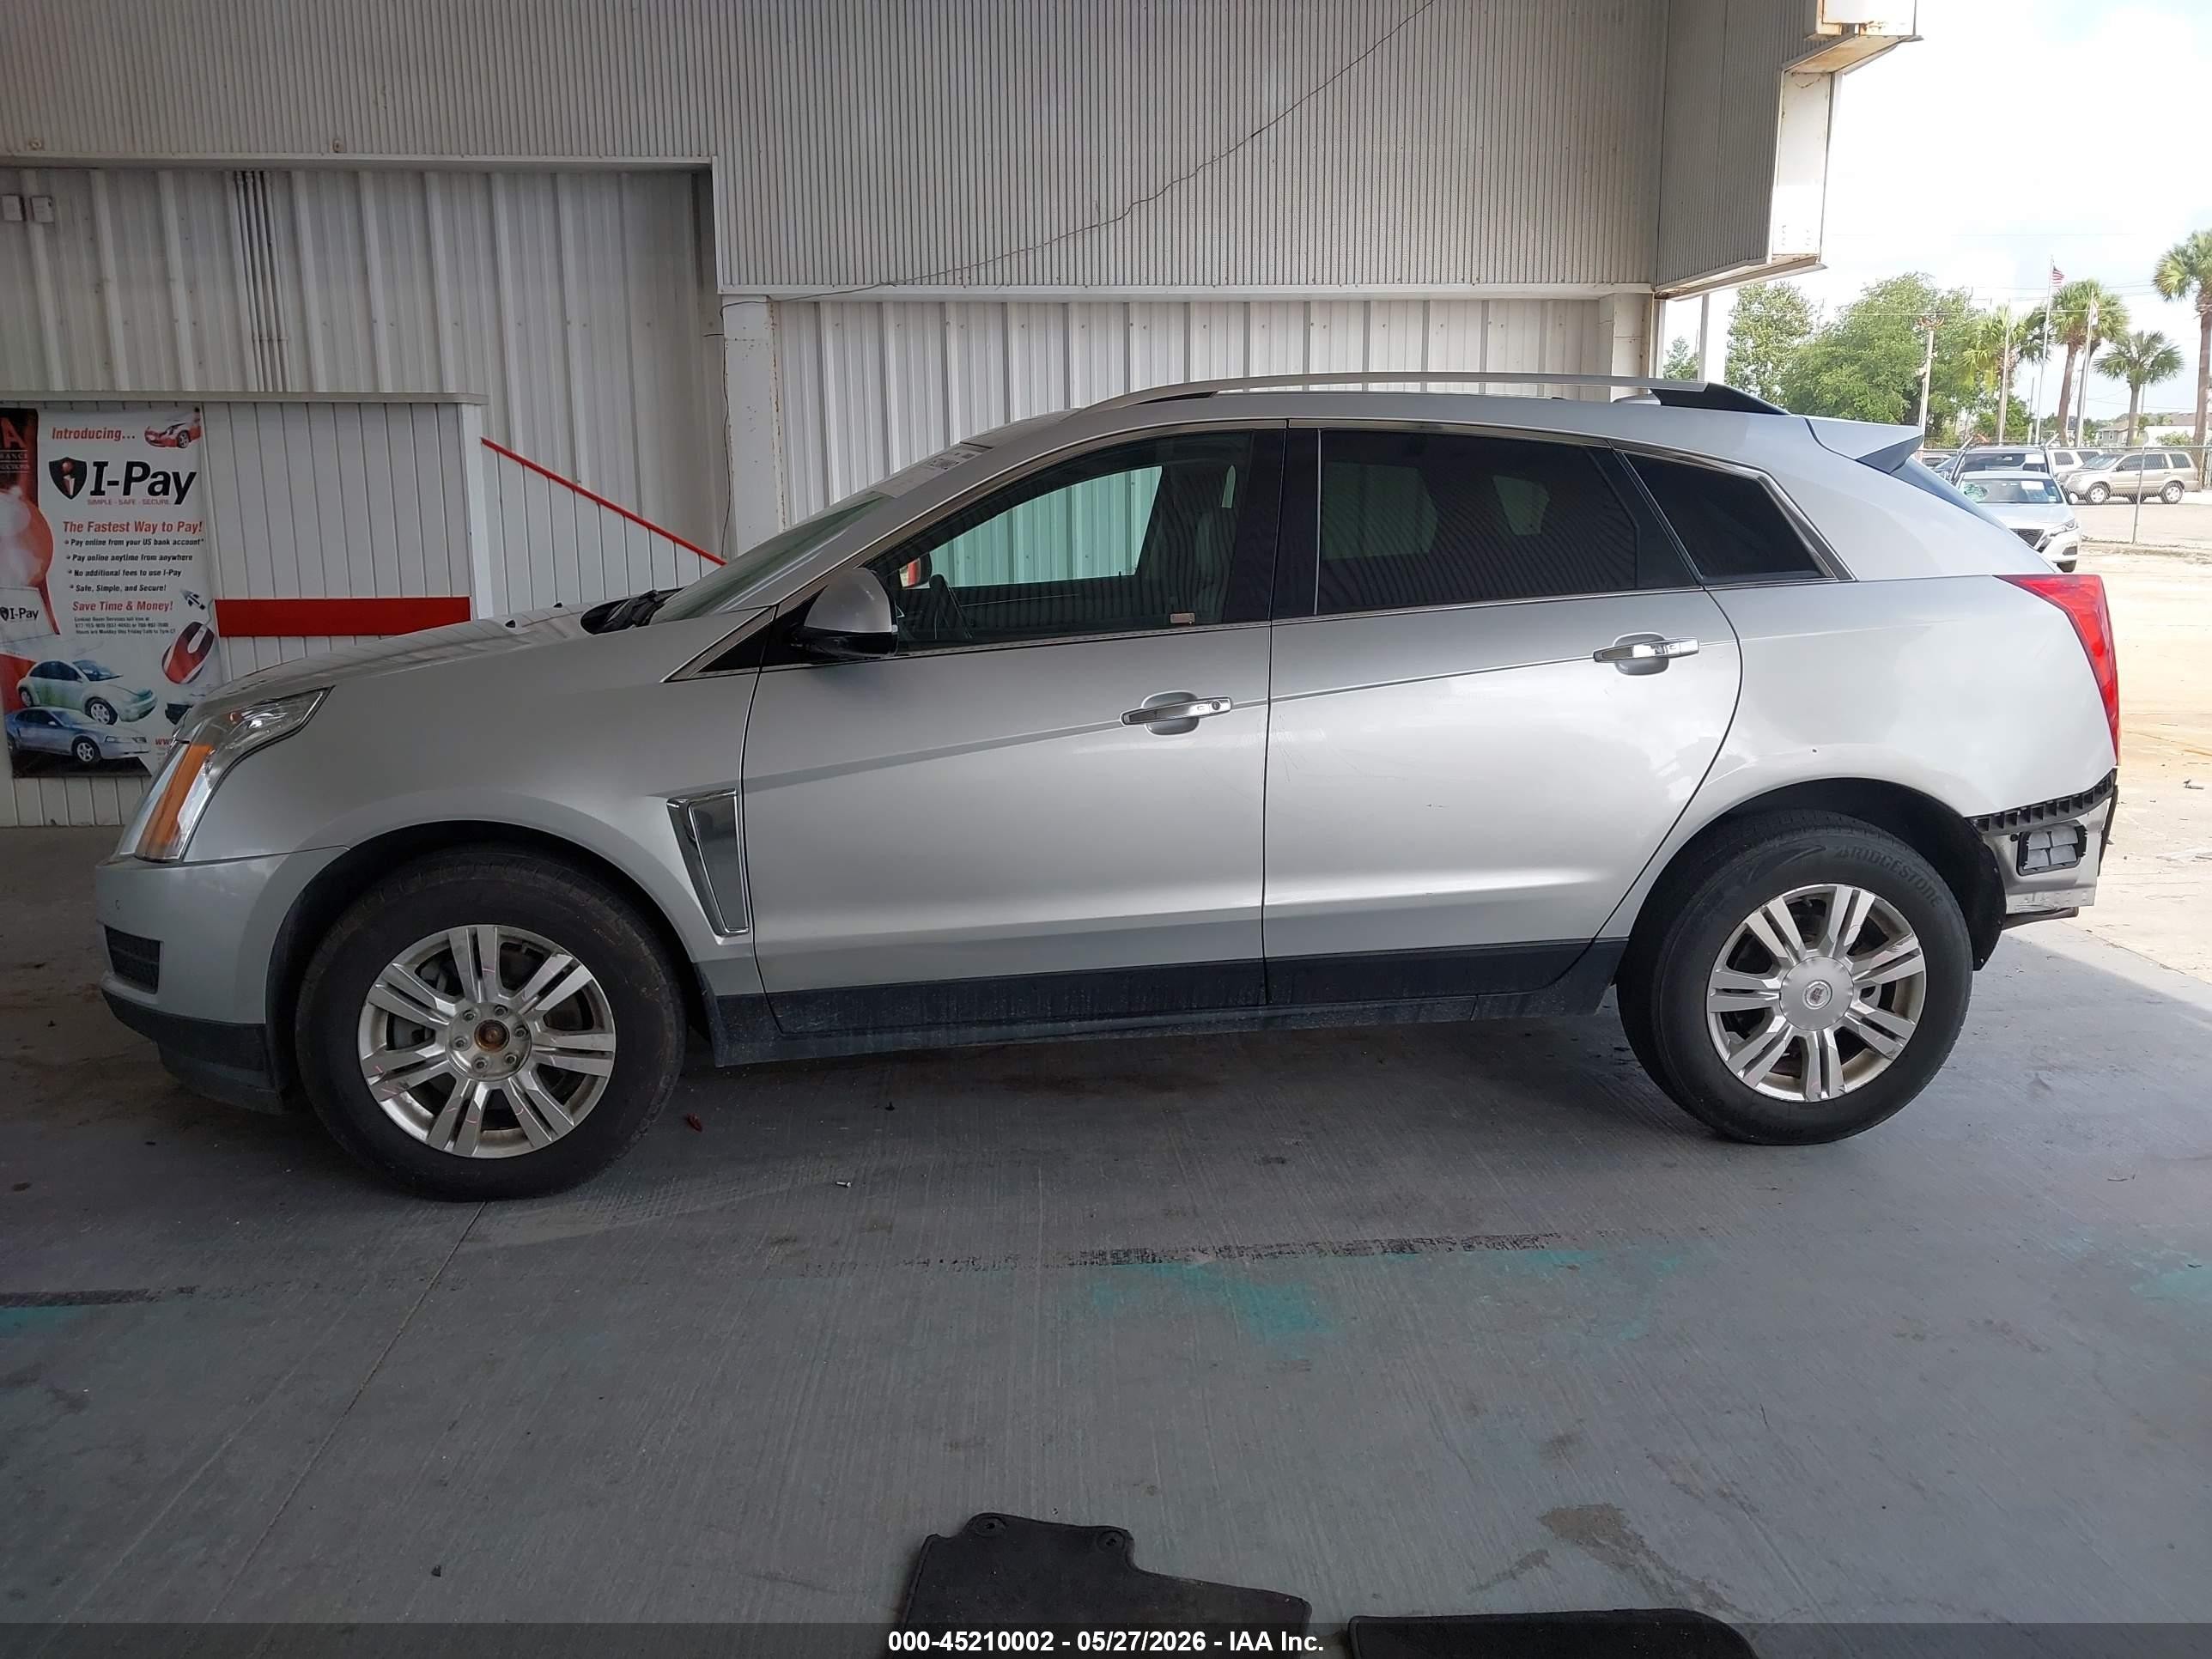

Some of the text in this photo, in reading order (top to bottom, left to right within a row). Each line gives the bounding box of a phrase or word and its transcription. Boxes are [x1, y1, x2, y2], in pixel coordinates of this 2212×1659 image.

[52, 427, 136, 441] Introducing...
[89, 460, 197, 505] I-Pay
[63, 521, 203, 534] The Fastest Way to Pay!
[70, 538, 83, 547] Pay
[72, 554, 85, 562] Pay
[111, 554, 138, 562] anytime
[159, 554, 193, 562] anywhere
[72, 601, 173, 612] Save Time & Money!
[9, 607, 40, 621] I-Pay
